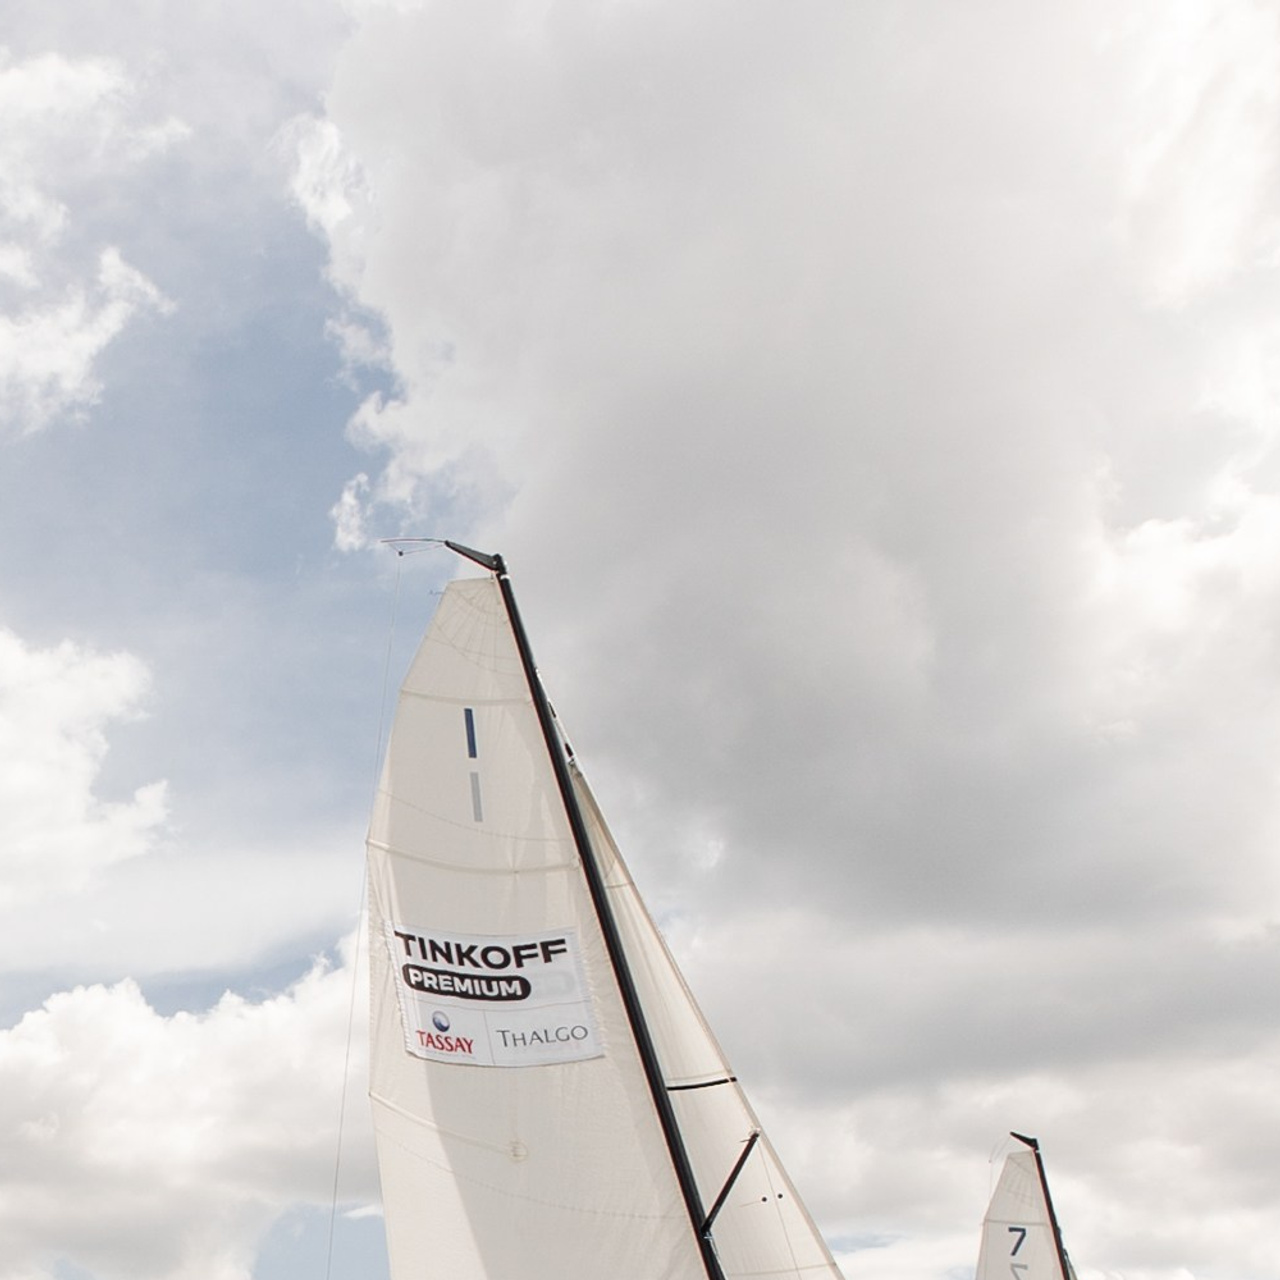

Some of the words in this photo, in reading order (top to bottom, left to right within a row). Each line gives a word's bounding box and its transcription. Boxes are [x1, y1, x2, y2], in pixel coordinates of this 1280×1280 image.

[394, 930, 567, 969] TINKOFF
[408, 969, 523, 996] PREMIUM
[416, 1030, 474, 1054] TASSAY
[496, 1025, 588, 1048] THALGO
[1008, 1227, 1027, 1256] 7
